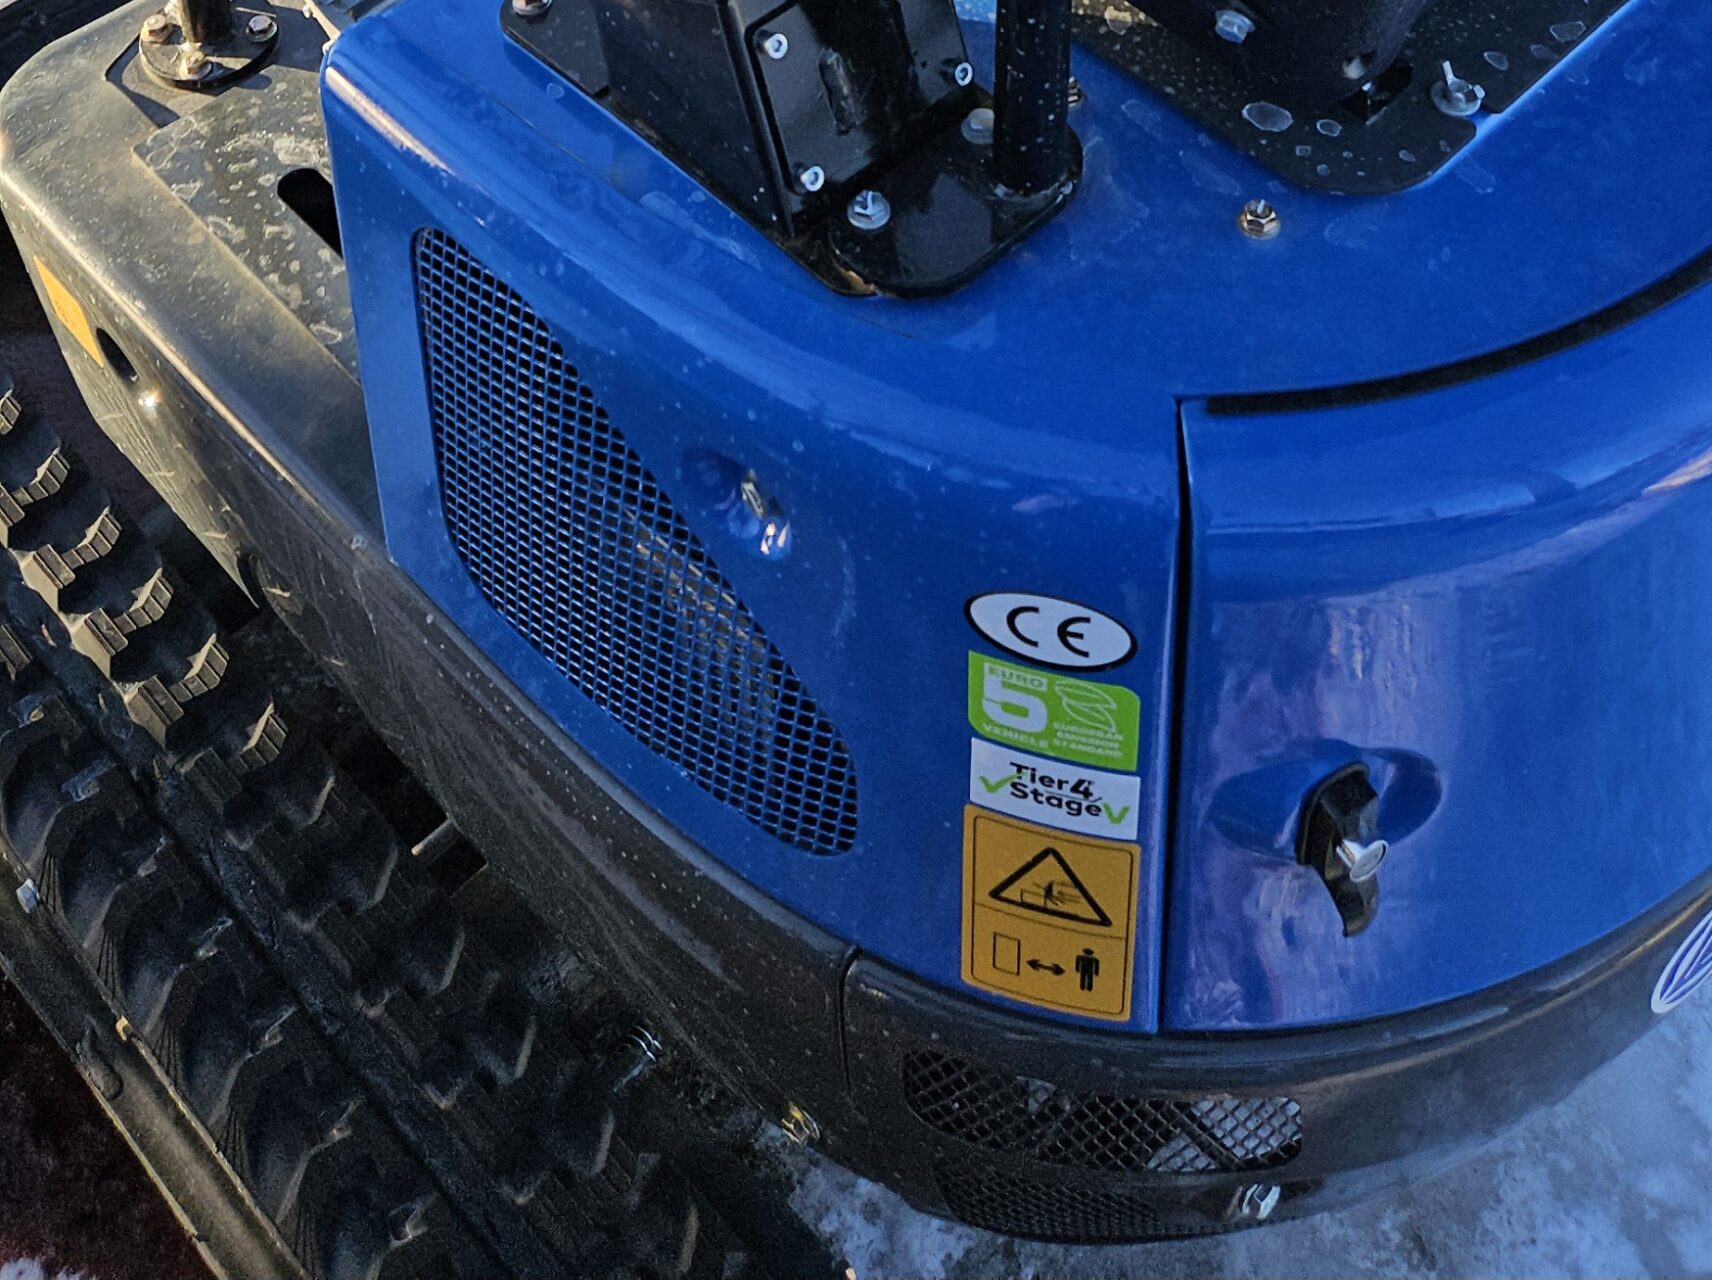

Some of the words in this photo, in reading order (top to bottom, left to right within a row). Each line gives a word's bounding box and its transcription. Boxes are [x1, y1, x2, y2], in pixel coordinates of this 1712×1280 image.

[1006, 606, 1091, 658] CE
[983, 663, 1048, 733] 5
[982, 723, 1048, 748] VEHICLE
[1010, 781, 1102, 816] Stage
